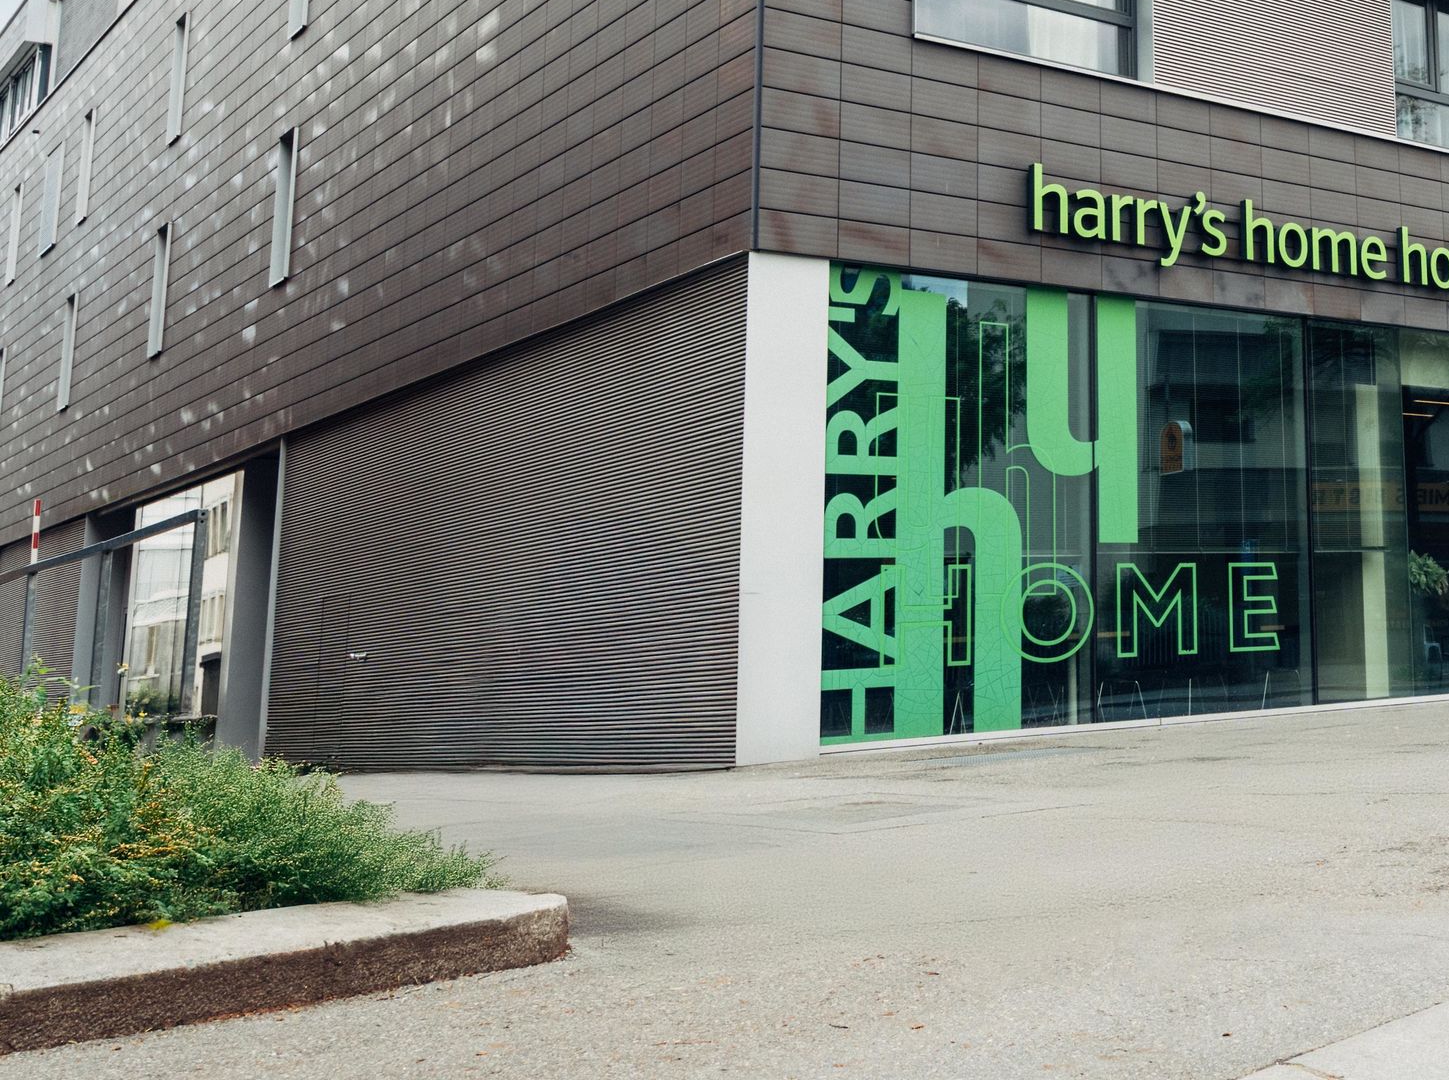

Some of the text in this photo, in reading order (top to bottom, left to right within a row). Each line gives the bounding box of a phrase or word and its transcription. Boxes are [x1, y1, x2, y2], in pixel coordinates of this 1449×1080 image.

[1031, 163, 1228, 267] harry's
[1244, 199, 1388, 280] home
[880, 561, 1280, 667] HOME
